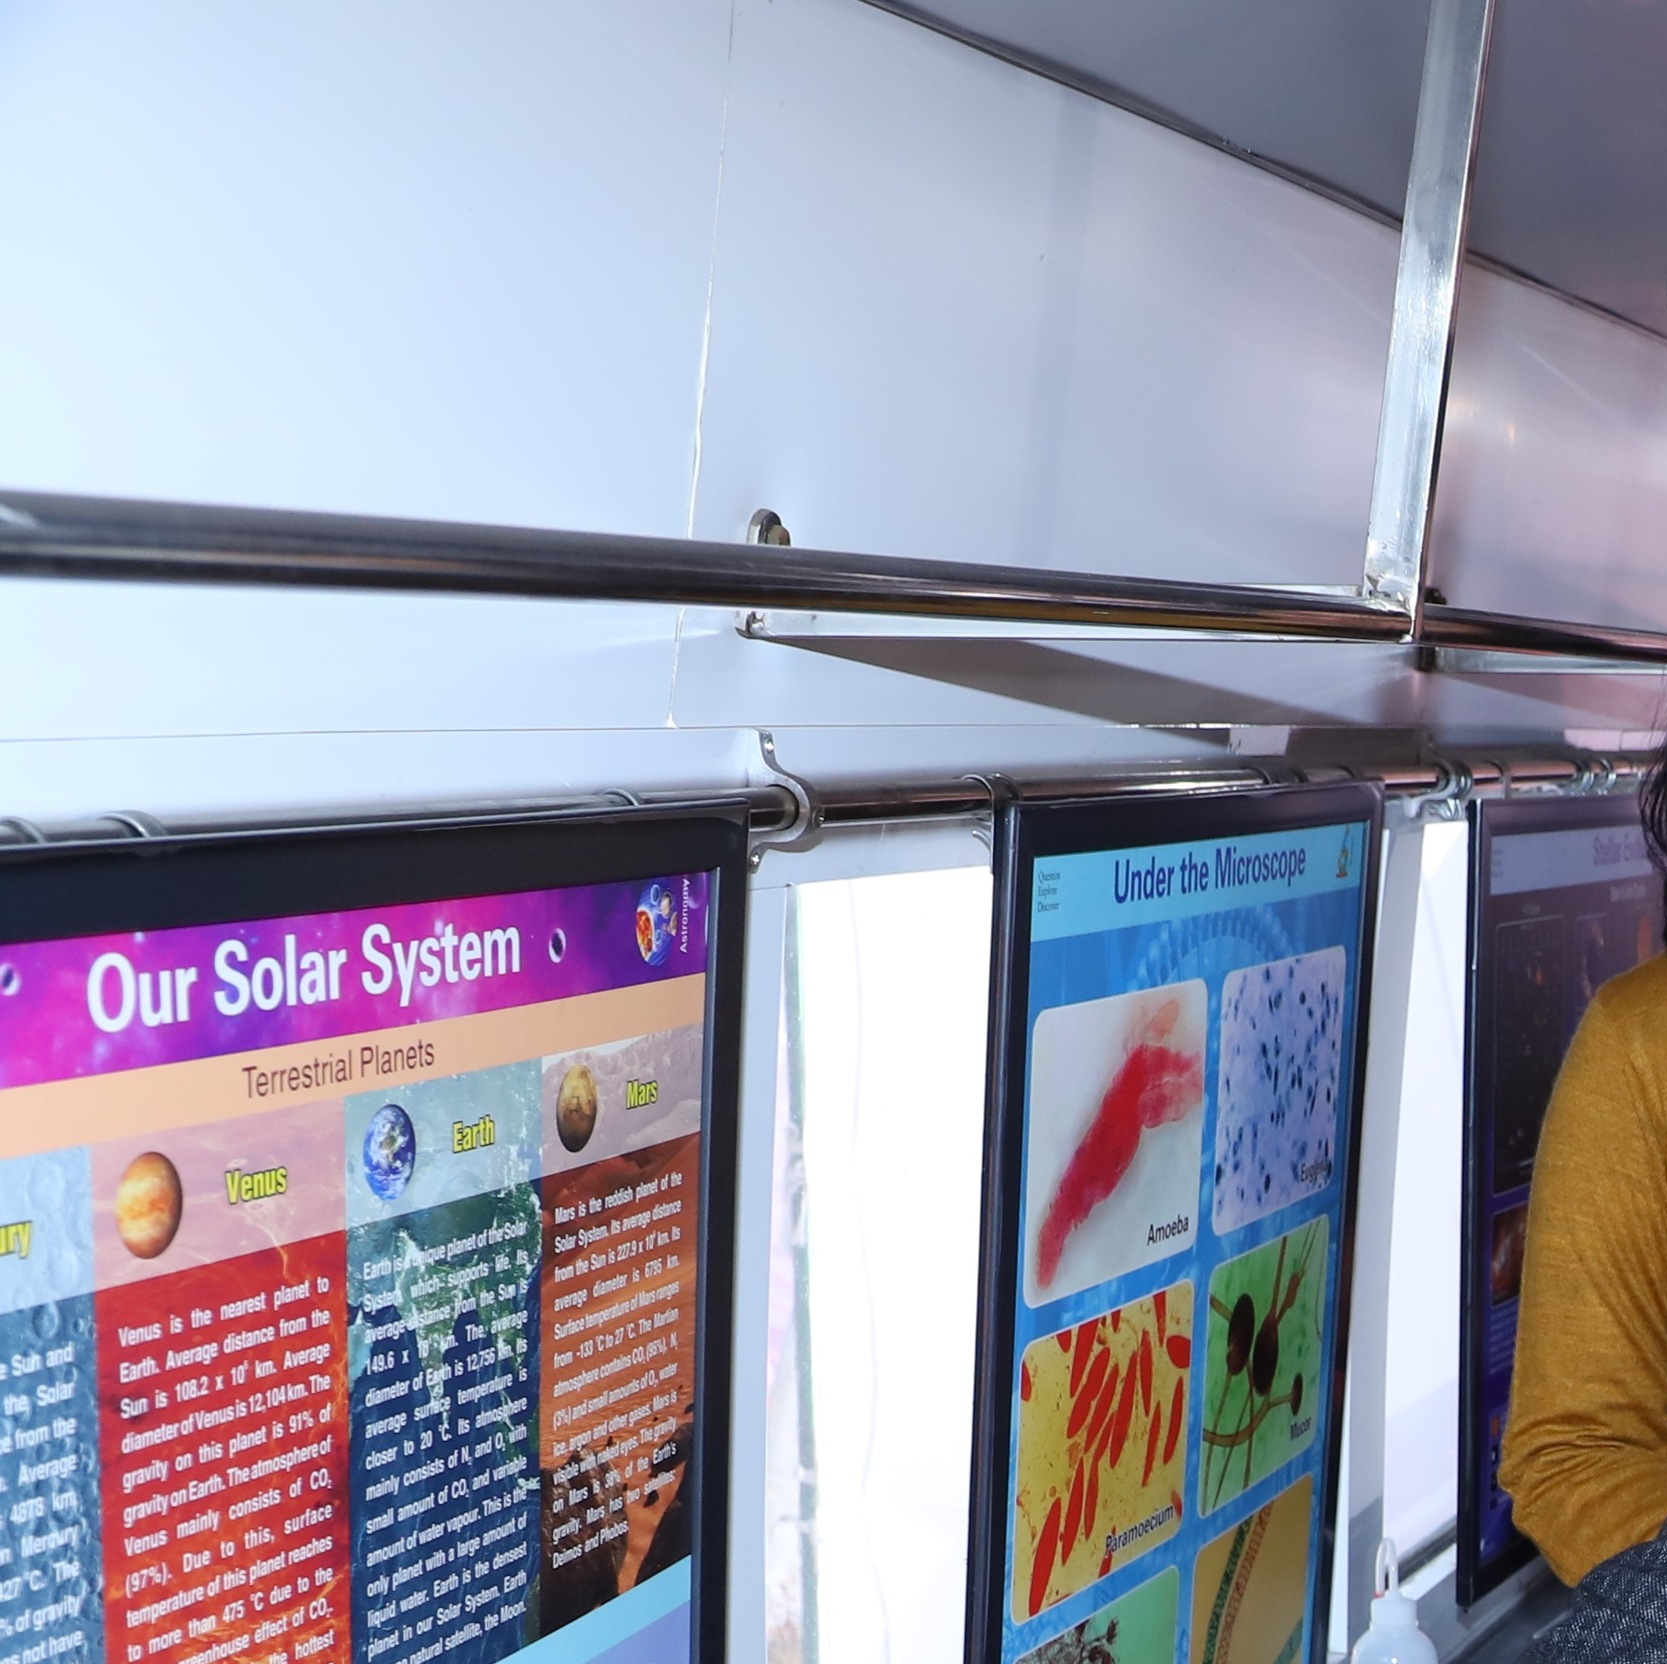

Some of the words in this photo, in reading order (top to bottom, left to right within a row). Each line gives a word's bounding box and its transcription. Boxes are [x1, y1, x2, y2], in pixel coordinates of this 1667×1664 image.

[1114, 857, 1174, 902] Under
[1180, 852, 1208, 893] the
[1215, 849, 1305, 887] Microscope
[680, 879, 690, 953] Astronomy
[87, 953, 196, 1031] Our
[214, 935, 345, 1014] Solar
[362, 926, 519, 1003] System
[242, 1051, 351, 1097] Terrestrial
[360, 1040, 433, 1076] Planets
[625, 1079, 659, 1109] Mars
[452, 1115, 495, 1153] Earth
[224, 1168, 288, 1204] Venus
[1147, 1213, 1189, 1246] Amoeba
[118, 1323, 161, 1346] Venus
[169, 1314, 182, 1333] is
[190, 1308, 211, 1327] the
[220, 1292, 265, 1319] nearest
[273, 1280, 309, 1309] planet
[316, 1276, 329, 1293] to
[119, 1357, 159, 1382] Earth.
[165, 1342, 218, 1369] Average
[223, 1326, 274, 1352] distance
[279, 1317, 306, 1336] from
[311, 1309, 330, 1327] the
[120, 1397, 148, 1418] Sun
[155, 1389, 167, 1408] is
[175, 1376, 208, 1401] 108.2
[215, 1375, 223, 1390] x
[255, 1360, 276, 1377] km.
[283, 1343, 329, 1368] Average
[121, 1423, 179, 1453] diameter
[179, 1413, 194, 1434] of
[193, 1406, 234, 1429] Venus
[235, 1399, 247, 1417] is
[248, 1385, 286, 1412] 12,104
[286, 1383, 308, 1400] km.
[308, 1374, 330, 1393] The
[122, 1460, 167, 1493] gravity
[175, 1453, 192, 1470] on
[198, 1441, 222, 1462] this
[229, 1426, 266, 1457] planet
[272, 1420, 283, 1438] is
[289, 1410, 313, 1432] 91%
[318, 1402, 331, 1422] of
[1290, 1416, 1311, 1440] Mucor
[123, 1494, 168, 1527] gravity
[169, 1488, 187, 1506] on
[188, 1474, 225, 1500] Earth.
[226, 1467, 250, 1486] The
[250, 1444, 318, 1478] atmosphere
[317, 1434, 332, 1454] of
[124, 1530, 167, 1555] Venus
[176, 1509, 219, 1537] mainly
[228, 1489, 280, 1519] consists
[289, 1477, 301, 1497] of
[182, 1550, 210, 1572] Due
[220, 1541, 234, 1558] to
[244, 1526, 274, 1548] this,
[284, 1504, 331, 1533] surface
[1105, 1505, 1175, 1556] Paramoecium
[126, 1586, 204, 1626] temperature
[206, 1575, 220, 1596] of
[222, 1568, 246, 1589] this
[249, 1551, 285, 1584] planet
[288, 1536, 332, 1564] reaches
[367, 1630, 398, 1661] planet
[402, 1624, 412, 1641] in
[416, 1616, 433, 1634] our
[436, 1603, 461, 1624] Solar
[465, 1586, 499, 1612] System.
[503, 1569, 526, 1592] Earth
[444, 1623, 482, 1650] satellite,
[484, 1613, 498, 1630] the
[500, 1600, 526, 1622] Moon.
